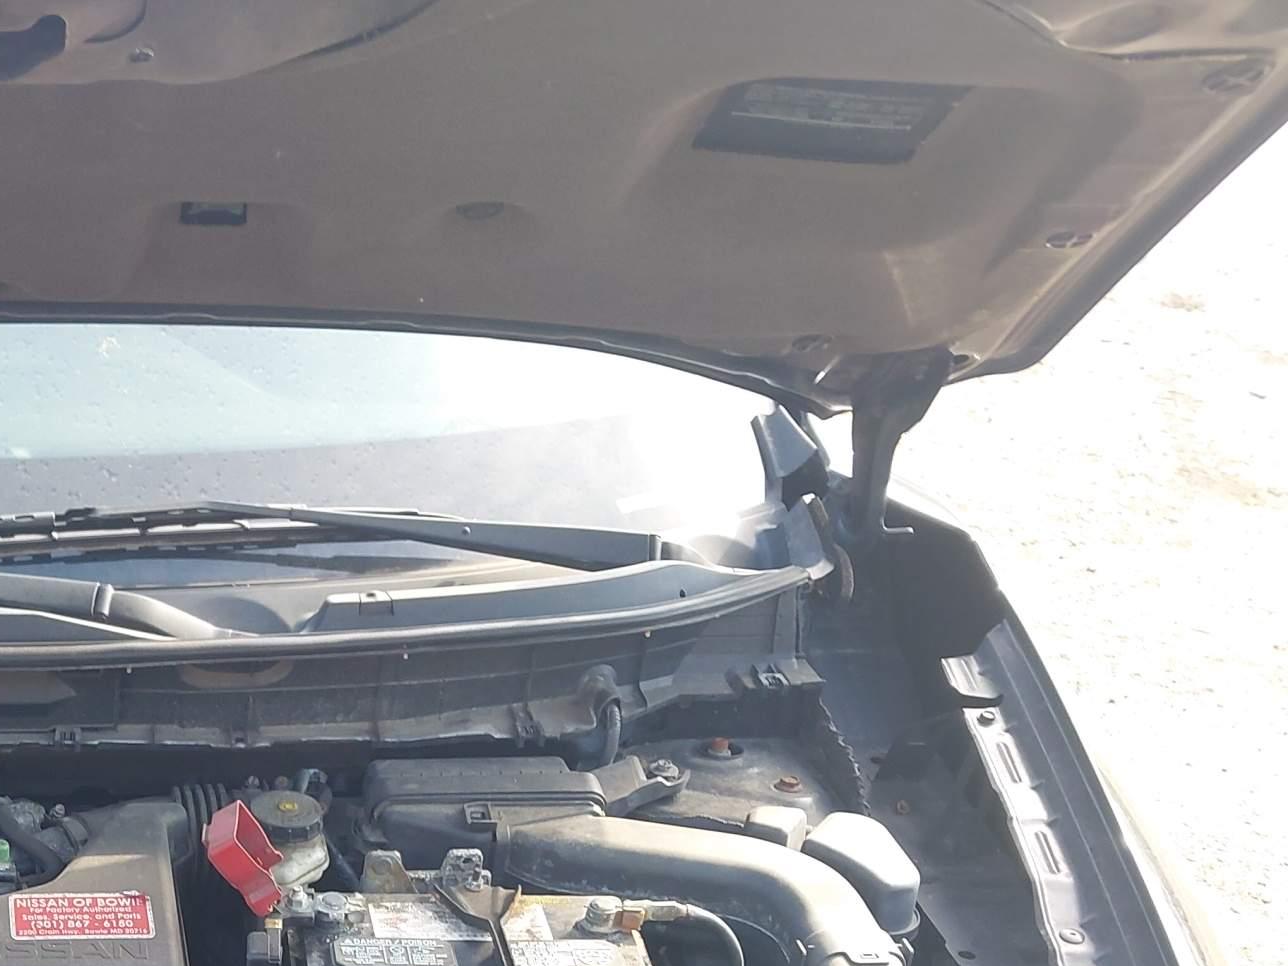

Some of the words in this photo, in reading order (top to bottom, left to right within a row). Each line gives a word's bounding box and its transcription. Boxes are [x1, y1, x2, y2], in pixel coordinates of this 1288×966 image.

[16, 898, 69, 908] NISSAN
[72, 898, 93, 907] OF
[94, 912, 115, 920] and
[117, 912, 142, 920] Parts
[30, 920, 64, 931] (301)
[352, 938, 392, 946] DANGER
[401, 939, 437, 947] POISON
